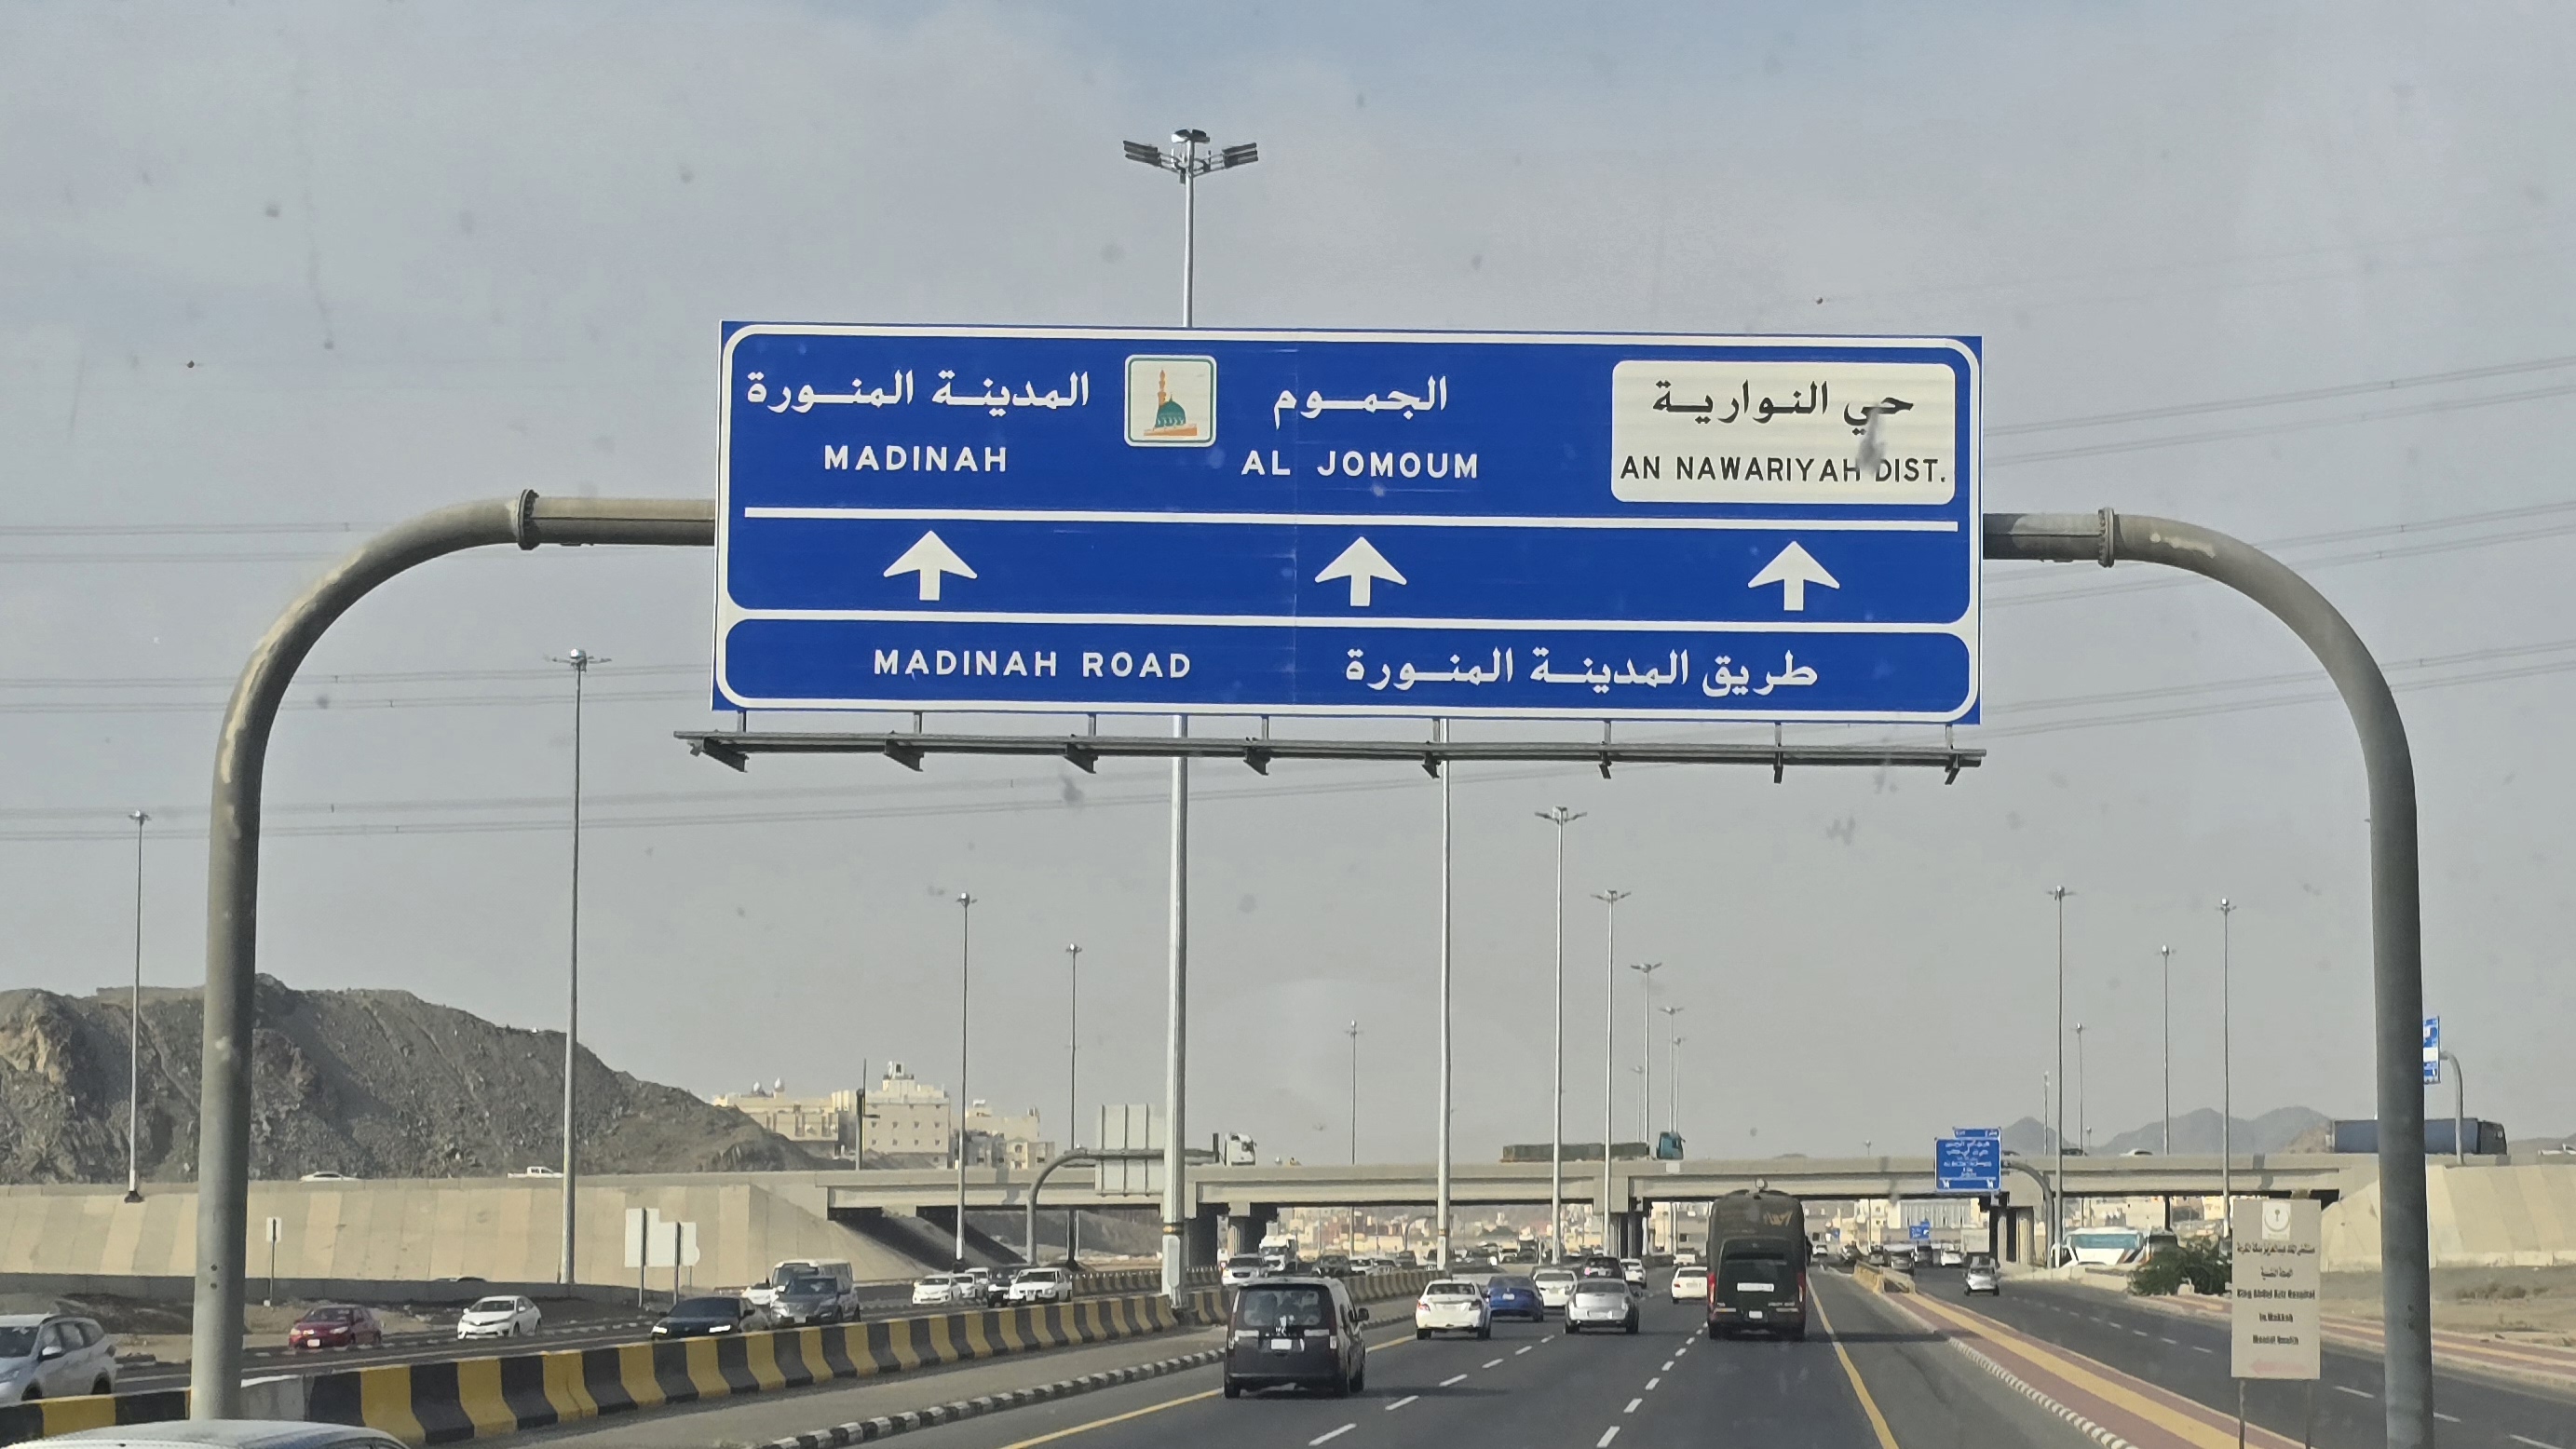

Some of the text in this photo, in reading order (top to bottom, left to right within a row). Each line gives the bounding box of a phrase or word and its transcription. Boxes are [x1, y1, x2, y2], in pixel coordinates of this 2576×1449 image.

[747, 369, 1089, 417] المدينة المنورة
[1273, 374, 1447, 430] الجموم
[1652, 379, 1914, 436] حي النوارية
[824, 444, 1007, 472] MADINAH
[1241, 450, 1479, 479] AL JOMOUM
[1620, 455, 1946, 483] AN NAWARIYAH DIST.
[874, 649, 1190, 679] MADINAH ROAD
[1346, 646, 1818, 697] طريق المدينة المنورة
